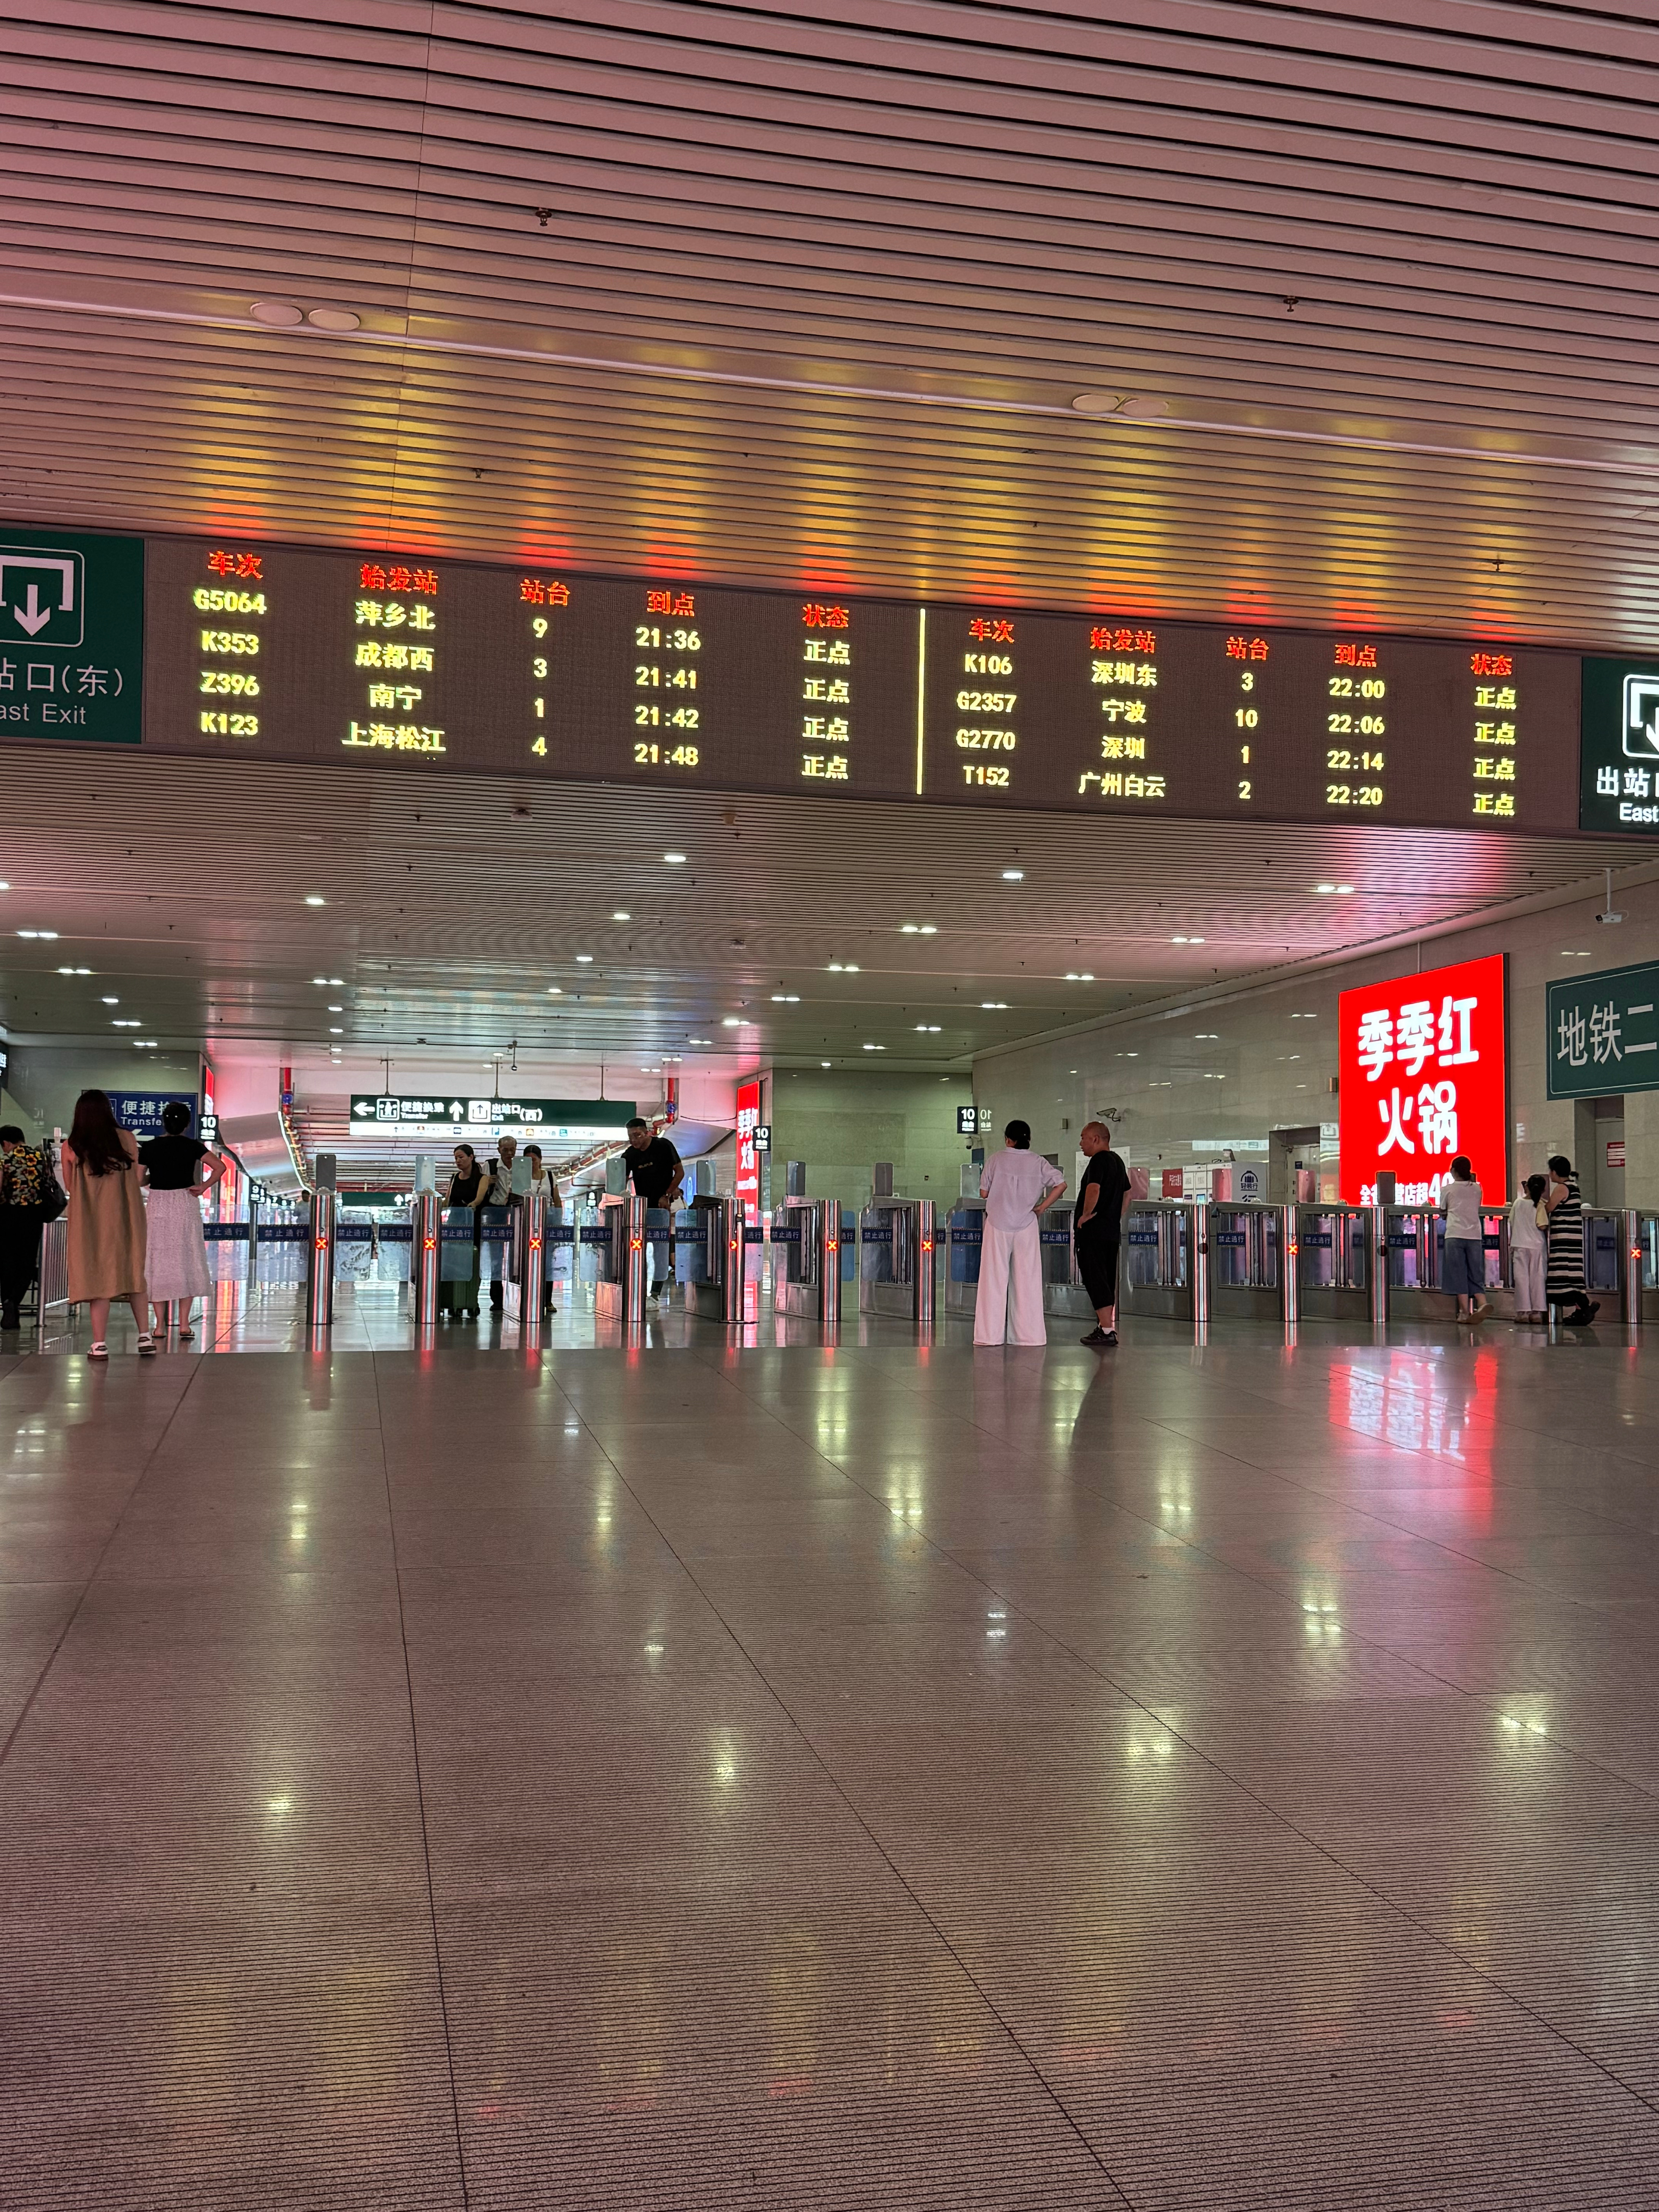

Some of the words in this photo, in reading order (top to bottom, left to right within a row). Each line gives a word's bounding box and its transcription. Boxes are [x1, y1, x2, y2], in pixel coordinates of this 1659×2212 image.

[208, 551, 263, 580] 车次
[360, 563, 439, 595] 始发站
[520, 579, 570, 606] 站台
[647, 591, 695, 617] 到点
[802, 603, 849, 629] 状态
[193, 589, 267, 615] G5064
[355, 600, 436, 630] 萍乡北
[533, 618, 548, 638] 9
[635, 627, 701, 650] 21:36
[803, 639, 850, 665] 正点
[969, 618, 1015, 643] 车次
[1090, 627, 1156, 653] 始发站
[1226, 636, 1269, 660] 站台
[1334, 644, 1377, 667] 到点
[1470, 653, 1513, 676] 状态
[201, 630, 259, 655] K353
[355, 641, 434, 672] 成都西
[534, 658, 547, 678] 3
[635, 666, 696, 689] 21:41
[803, 678, 850, 704] 正点
[965, 654, 1013, 675] K106
[1091, 660, 1158, 687] 深圳东
[1241, 672, 1253, 691] 3
[1328, 678, 1385, 699] 22:00
[1474, 686, 1516, 710] 正点
[43, 703, 86, 724] Exit
[200, 672, 260, 696] Z396
[369, 683, 422, 710] 南宁
[534, 698, 544, 718] 1
[635, 705, 699, 728] 21:42
[802, 716, 849, 742] 正点
[957, 691, 1017, 713] G2357
[1102, 699, 1147, 723] 宁波
[1235, 709, 1258, 728] 10
[1328, 714, 1385, 735] 22:06
[1474, 722, 1516, 745] 正点
[201, 711, 258, 737] K123
[342, 721, 446, 752] 上海松江
[532, 737, 548, 756] 4
[634, 744, 699, 766] 21:48
[801, 755, 848, 780] 正点
[956, 729, 1016, 750] G2770
[1101, 735, 1145, 759] 深圳
[1241, 745, 1249, 764] 1
[1327, 750, 1384, 771] 22:14
[1473, 756, 1515, 780] 正点
[963, 765, 1009, 786] T152
[1078, 771, 1166, 797] 广州白云
[1238, 781, 1251, 799] 2
[1326, 785, 1383, 805] 22:20
[1472, 793, 1515, 816] 正点
[1597, 766, 1659, 797] 出站
[1620, 802, 1659, 823] East
[1358, 996, 1479, 1082] 季季红
[1557, 1001, 1657, 1066] 地铁二
[120, 1117, 163, 1125] Transfe
[201, 1116, 216, 1128] 10
[755, 1127, 769, 1139] 10
[961, 1108, 975, 1120] 10
[1377, 1080, 1458, 1156] 火锅
[582, 1230, 611, 1238] 禁止通行
